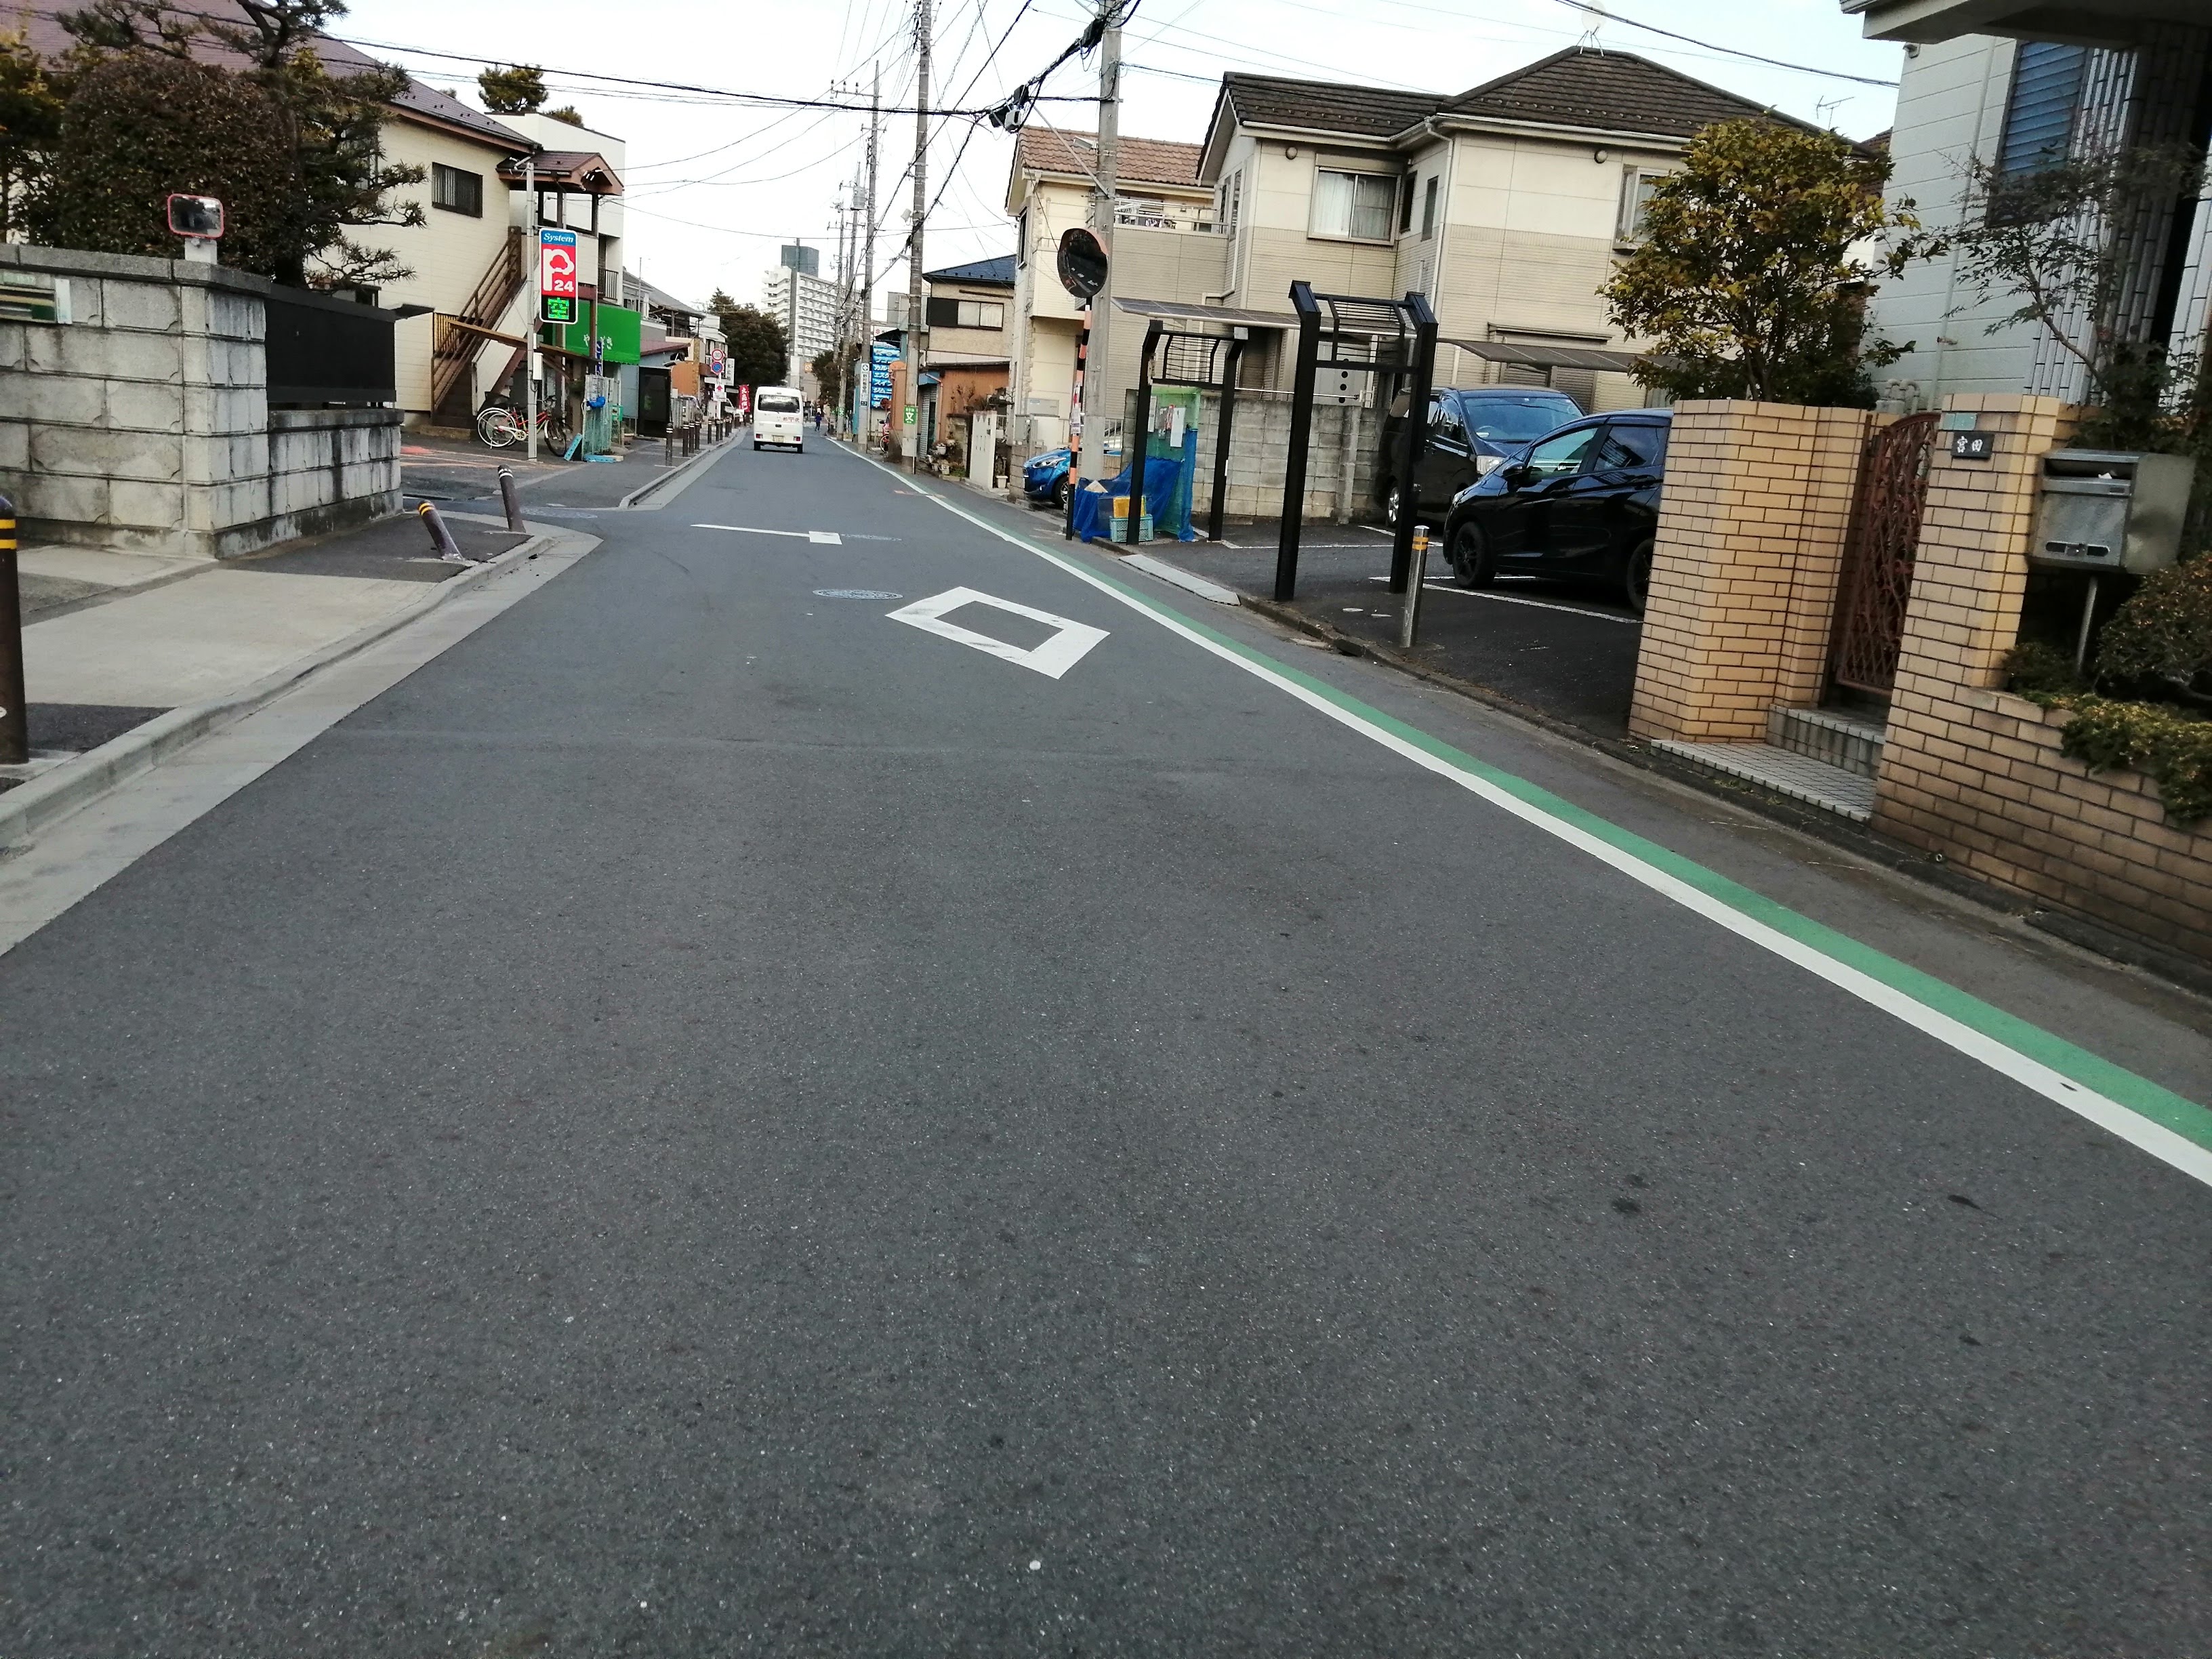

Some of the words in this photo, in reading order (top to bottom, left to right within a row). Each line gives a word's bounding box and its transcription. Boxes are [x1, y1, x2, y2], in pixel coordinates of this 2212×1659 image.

[543, 232, 574, 243] System
[554, 279, 574, 292] 24
[1957, 436, 1984, 453] 宮田
